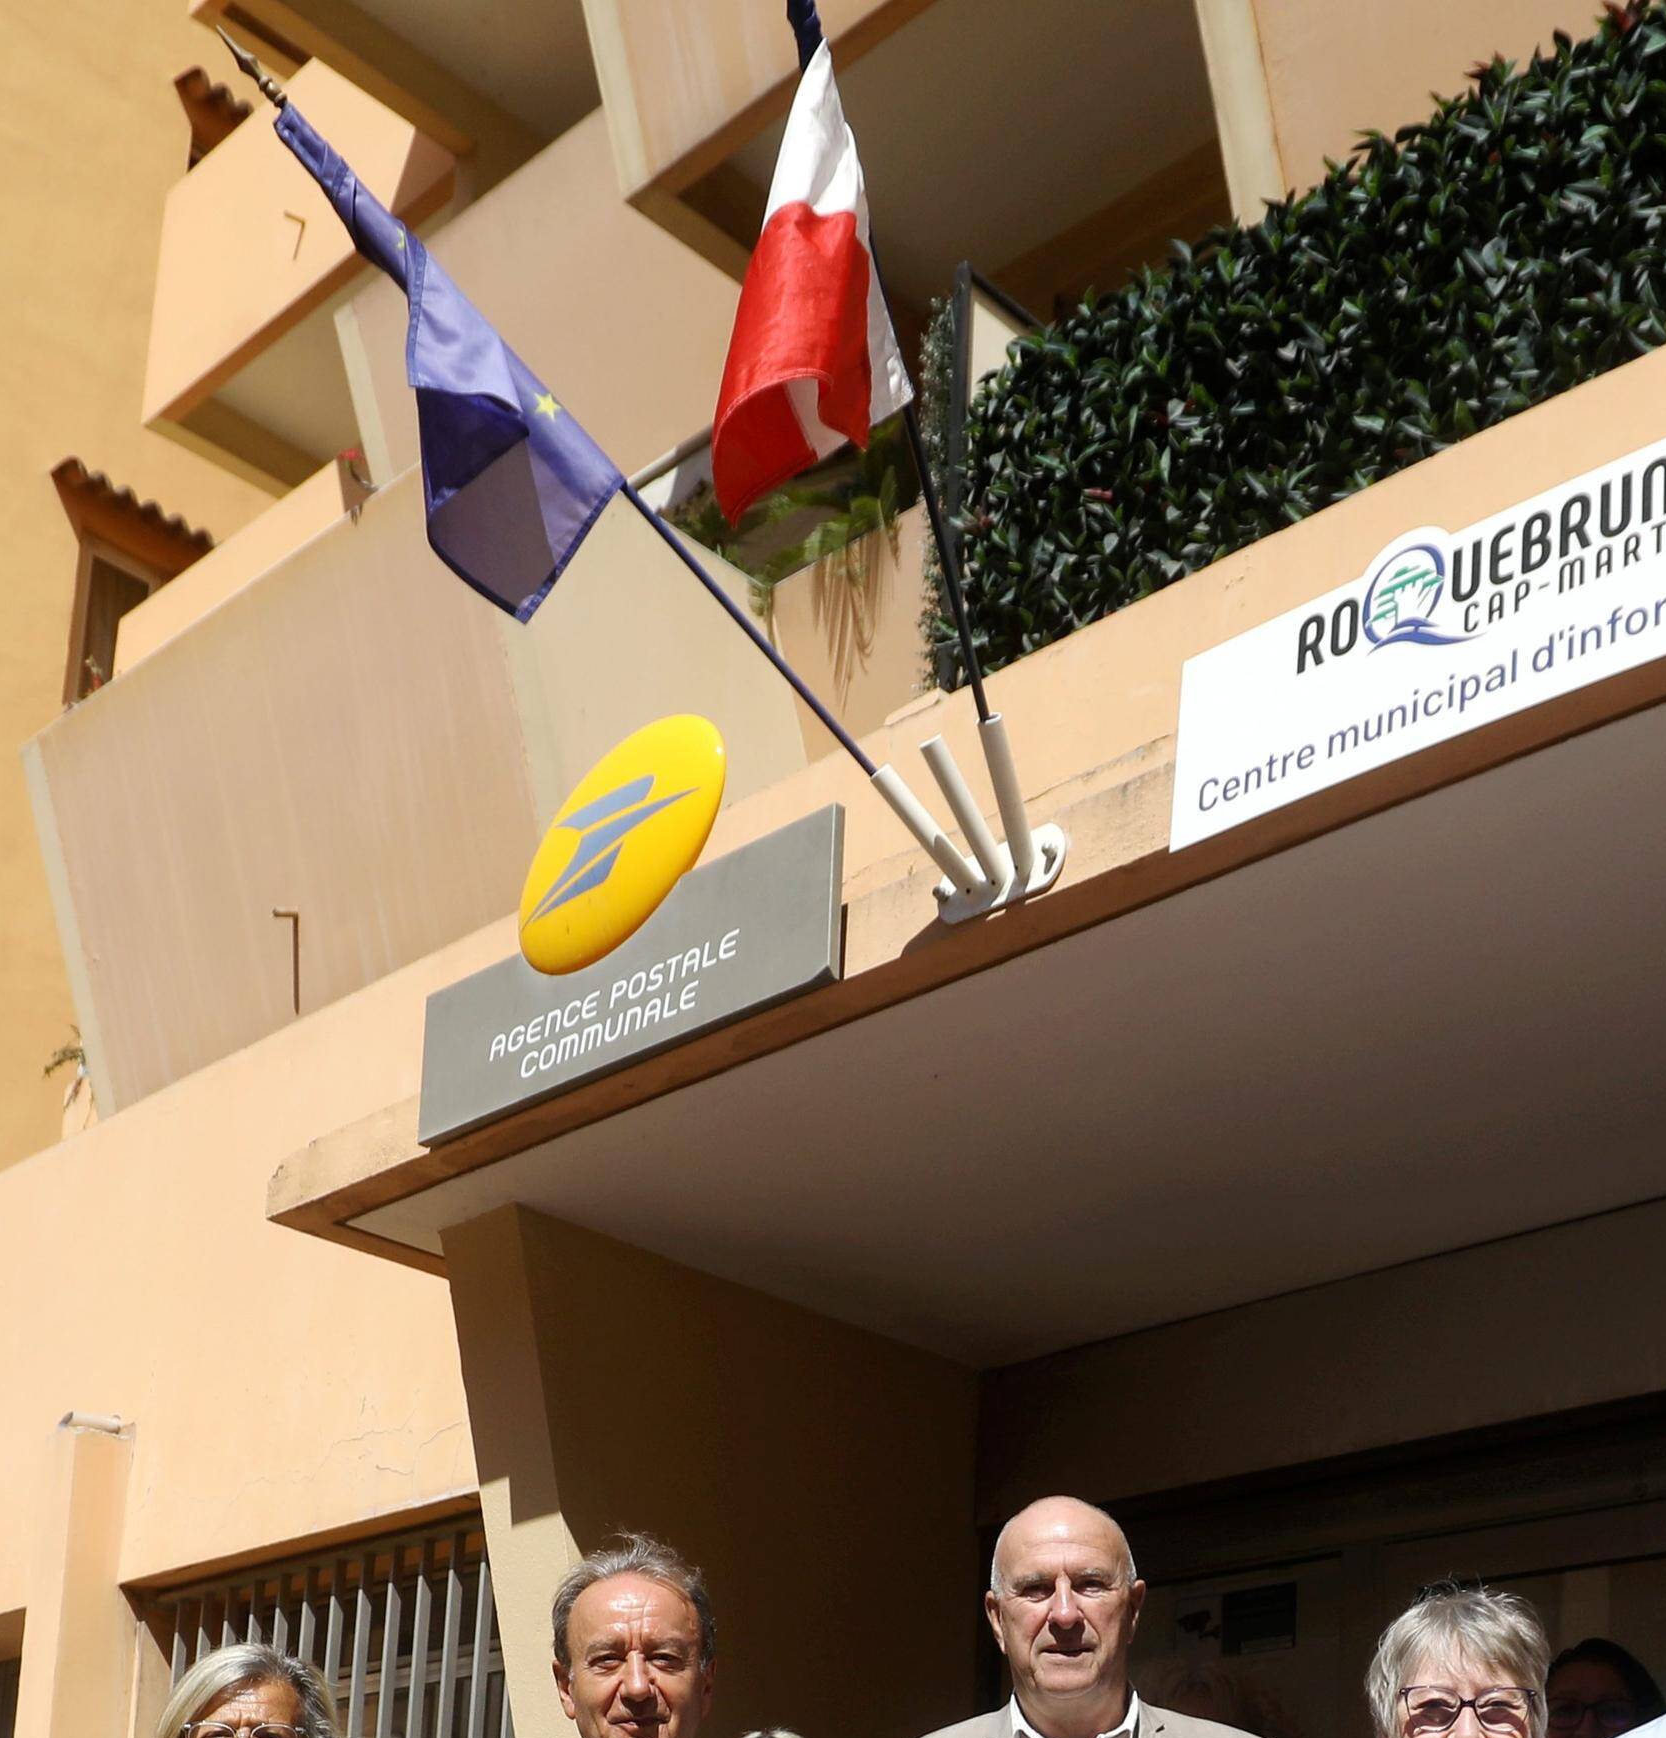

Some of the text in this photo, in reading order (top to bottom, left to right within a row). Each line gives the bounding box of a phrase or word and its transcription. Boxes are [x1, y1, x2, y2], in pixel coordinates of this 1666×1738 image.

[1198, 735, 1316, 813] Centre
[1327, 651, 1519, 760] municipal
[489, 928, 741, 1062] AGENCE POSTALE
[519, 980, 700, 1079] COMMUNALE
